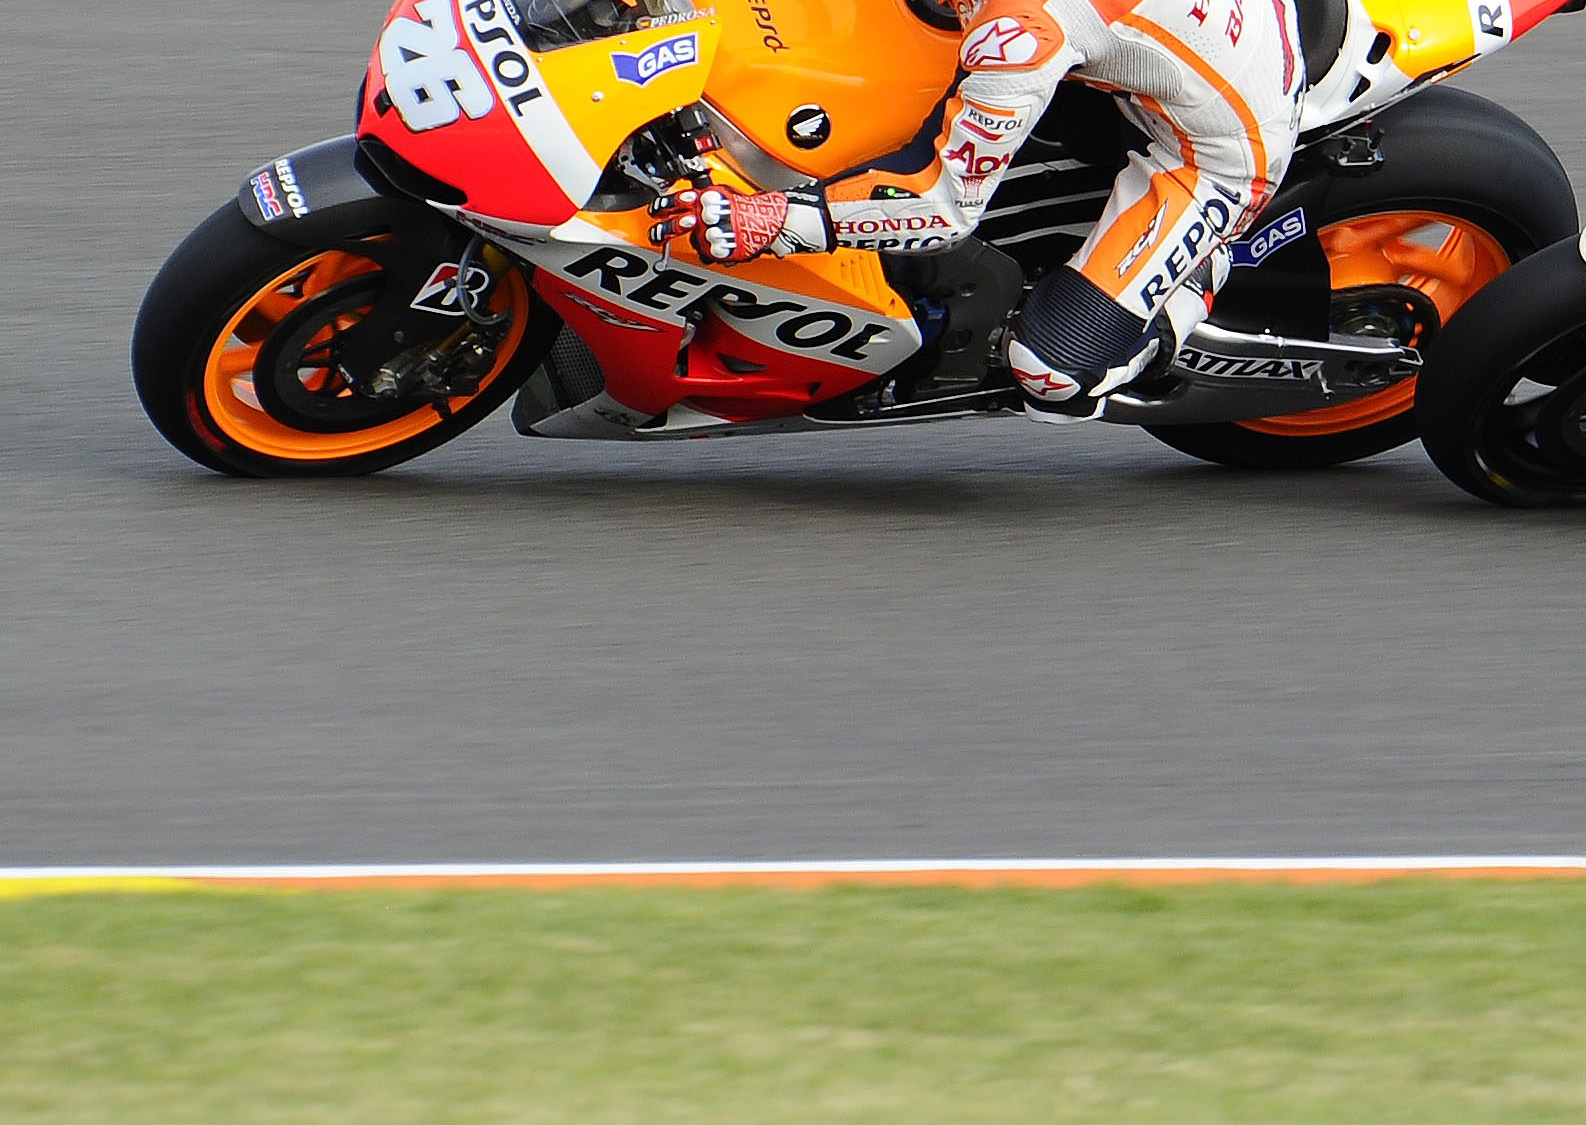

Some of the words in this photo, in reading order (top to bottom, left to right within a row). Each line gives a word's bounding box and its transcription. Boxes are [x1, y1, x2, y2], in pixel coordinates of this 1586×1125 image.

[650, 6, 716, 28] PEDROSA
[637, 38, 696, 79] GAS
[968, 108, 1023, 131] REPSOL
[274, 158, 310, 219] REPSOL
[835, 214, 952, 235] HONDA
[1250, 216, 1302, 259] GAS
[563, 246, 890, 360] REPSOL
